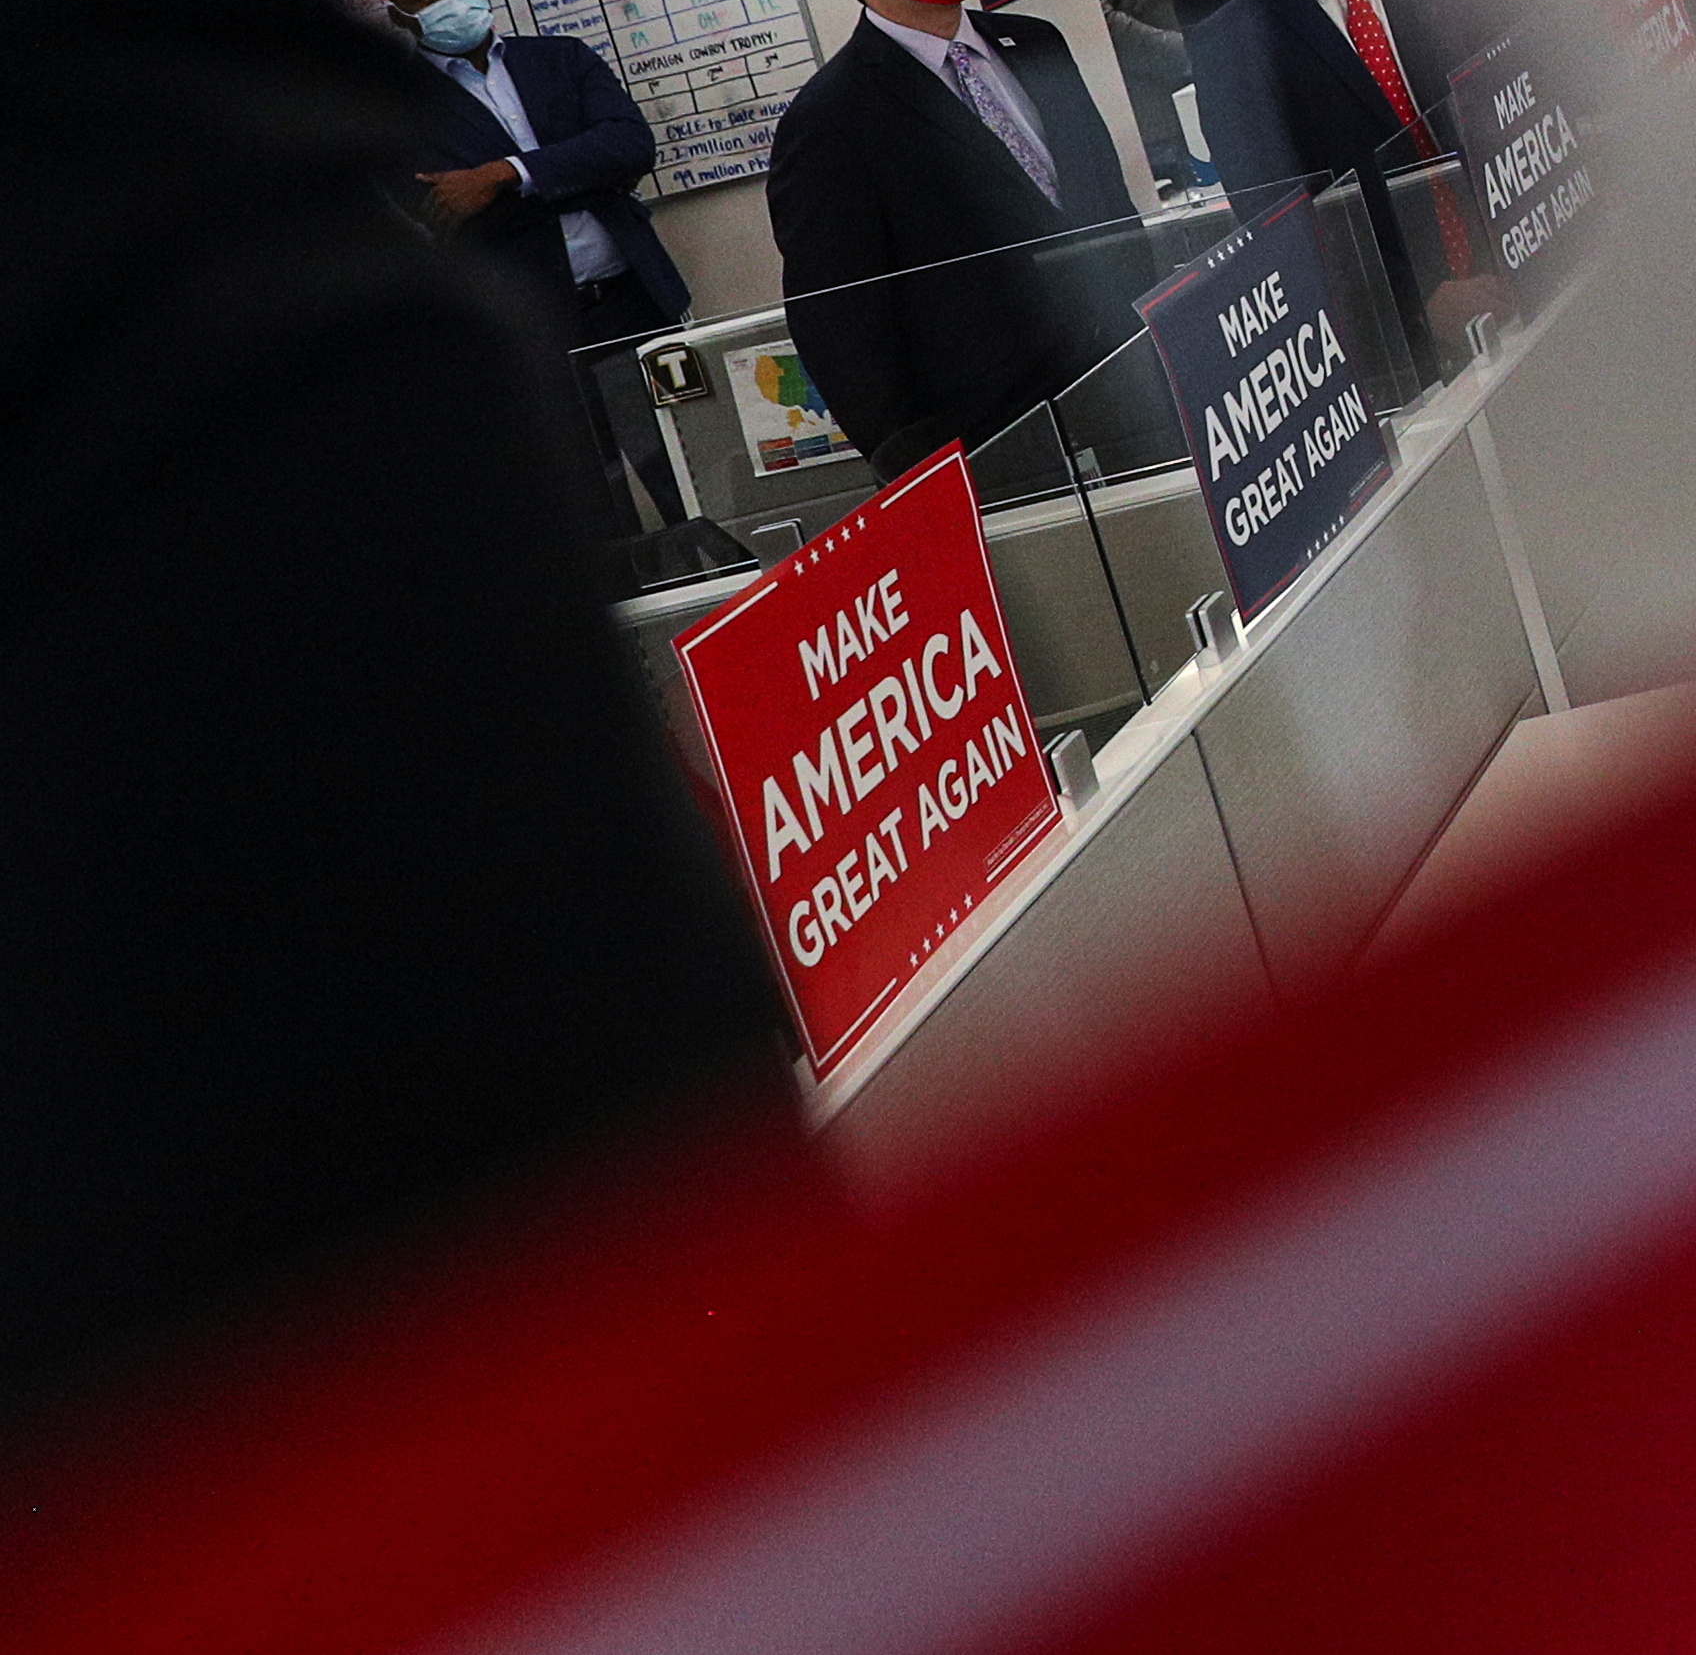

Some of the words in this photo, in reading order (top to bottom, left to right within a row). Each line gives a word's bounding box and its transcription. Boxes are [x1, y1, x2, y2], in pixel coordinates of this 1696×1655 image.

[629, 52, 683, 75] CAMPAIGN
[689, 42, 726, 60] COWBOY
[1494, 70, 1536, 130] MAKE
[689, 137, 744, 159] million
[699, 163, 745, 182] million
[1484, 105, 1578, 219] AMERICA
[1501, 201, 1554, 270] GREAT
[1549, 165, 1595, 229] AGAIN
[1218, 271, 1289, 358] MAKE
[657, 350, 687, 389] T
[1203, 309, 1346, 482] AMERICA
[1225, 444, 1305, 547] GREAT
[1304, 384, 1368, 478] AGAIN
[798, 568, 910, 701] MAKE
[760, 608, 1002, 883] AMERICA
[788, 807, 908, 968] GREAT
[918, 703, 1028, 850] AGAIN
